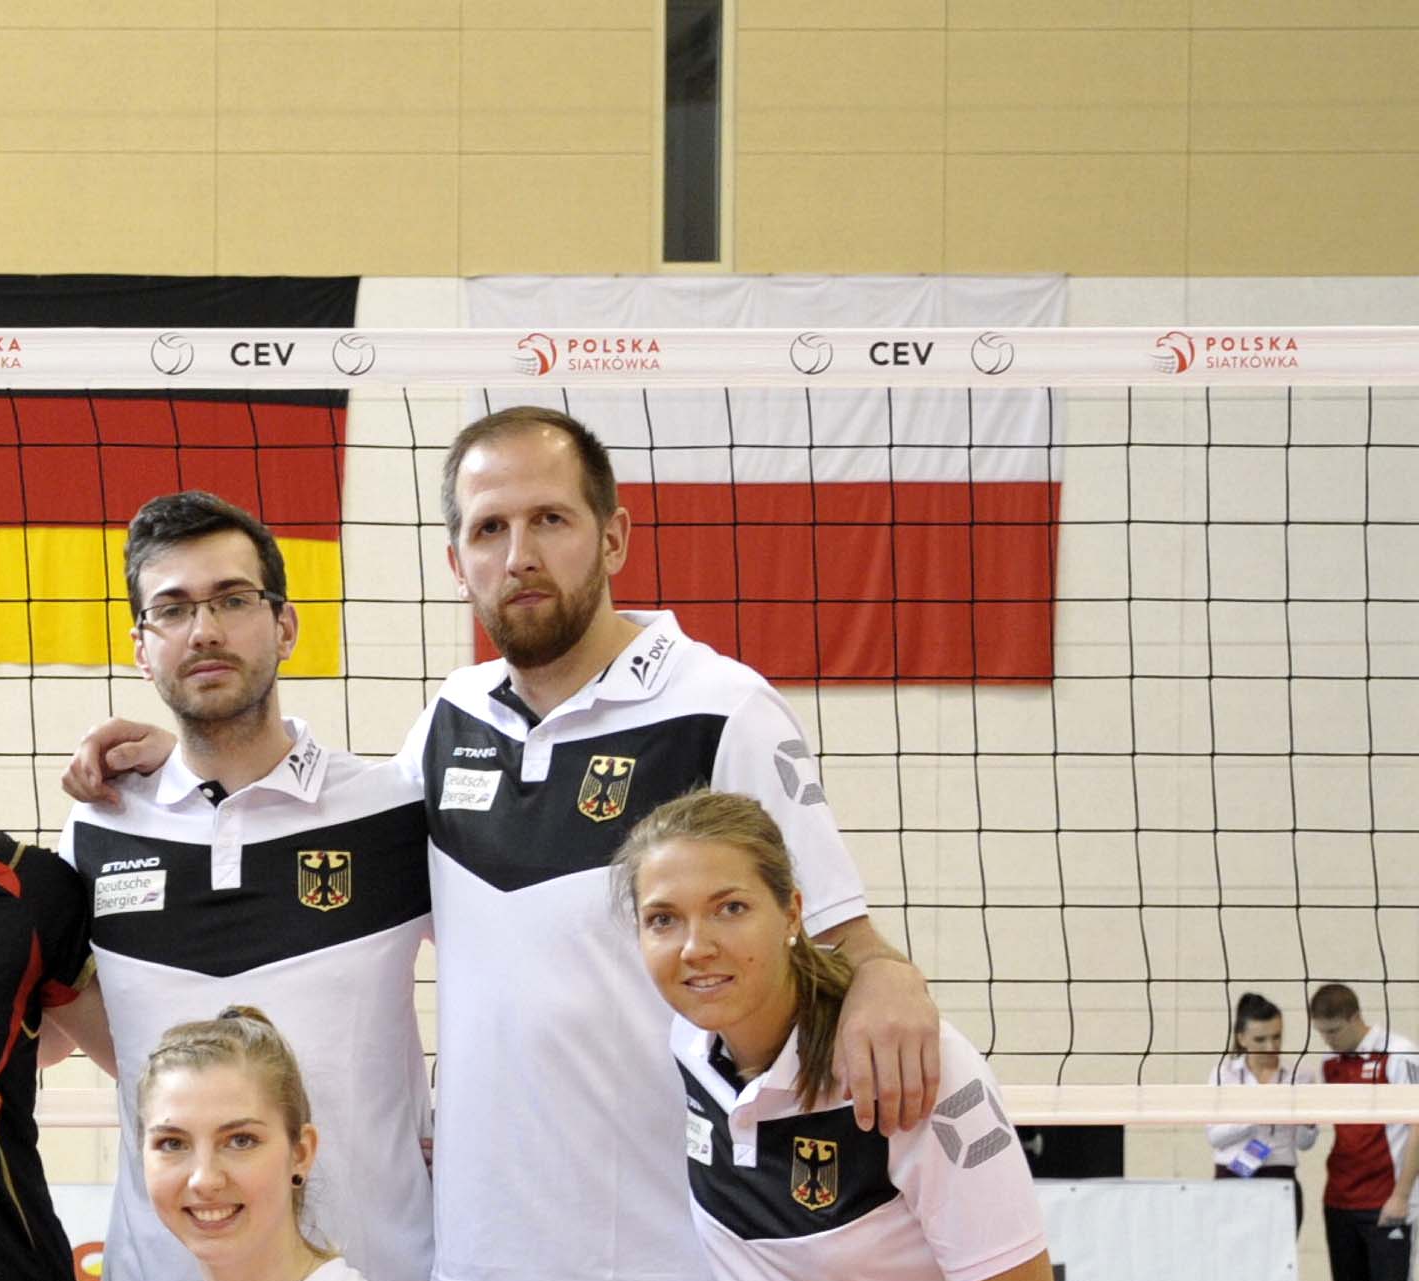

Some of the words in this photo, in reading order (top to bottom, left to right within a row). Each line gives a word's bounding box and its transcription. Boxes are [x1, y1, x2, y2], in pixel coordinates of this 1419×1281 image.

[567, 338, 660, 354] POLSKA
[1205, 336, 1298, 352] POLSKA
[230, 341, 294, 366] CEV
[869, 341, 933, 366] CEV
[1205, 353, 1298, 370] SIATKÓWKA
[567, 354, 660, 371] SIATKÓWKA
[101, 857, 161, 874] STANNO
